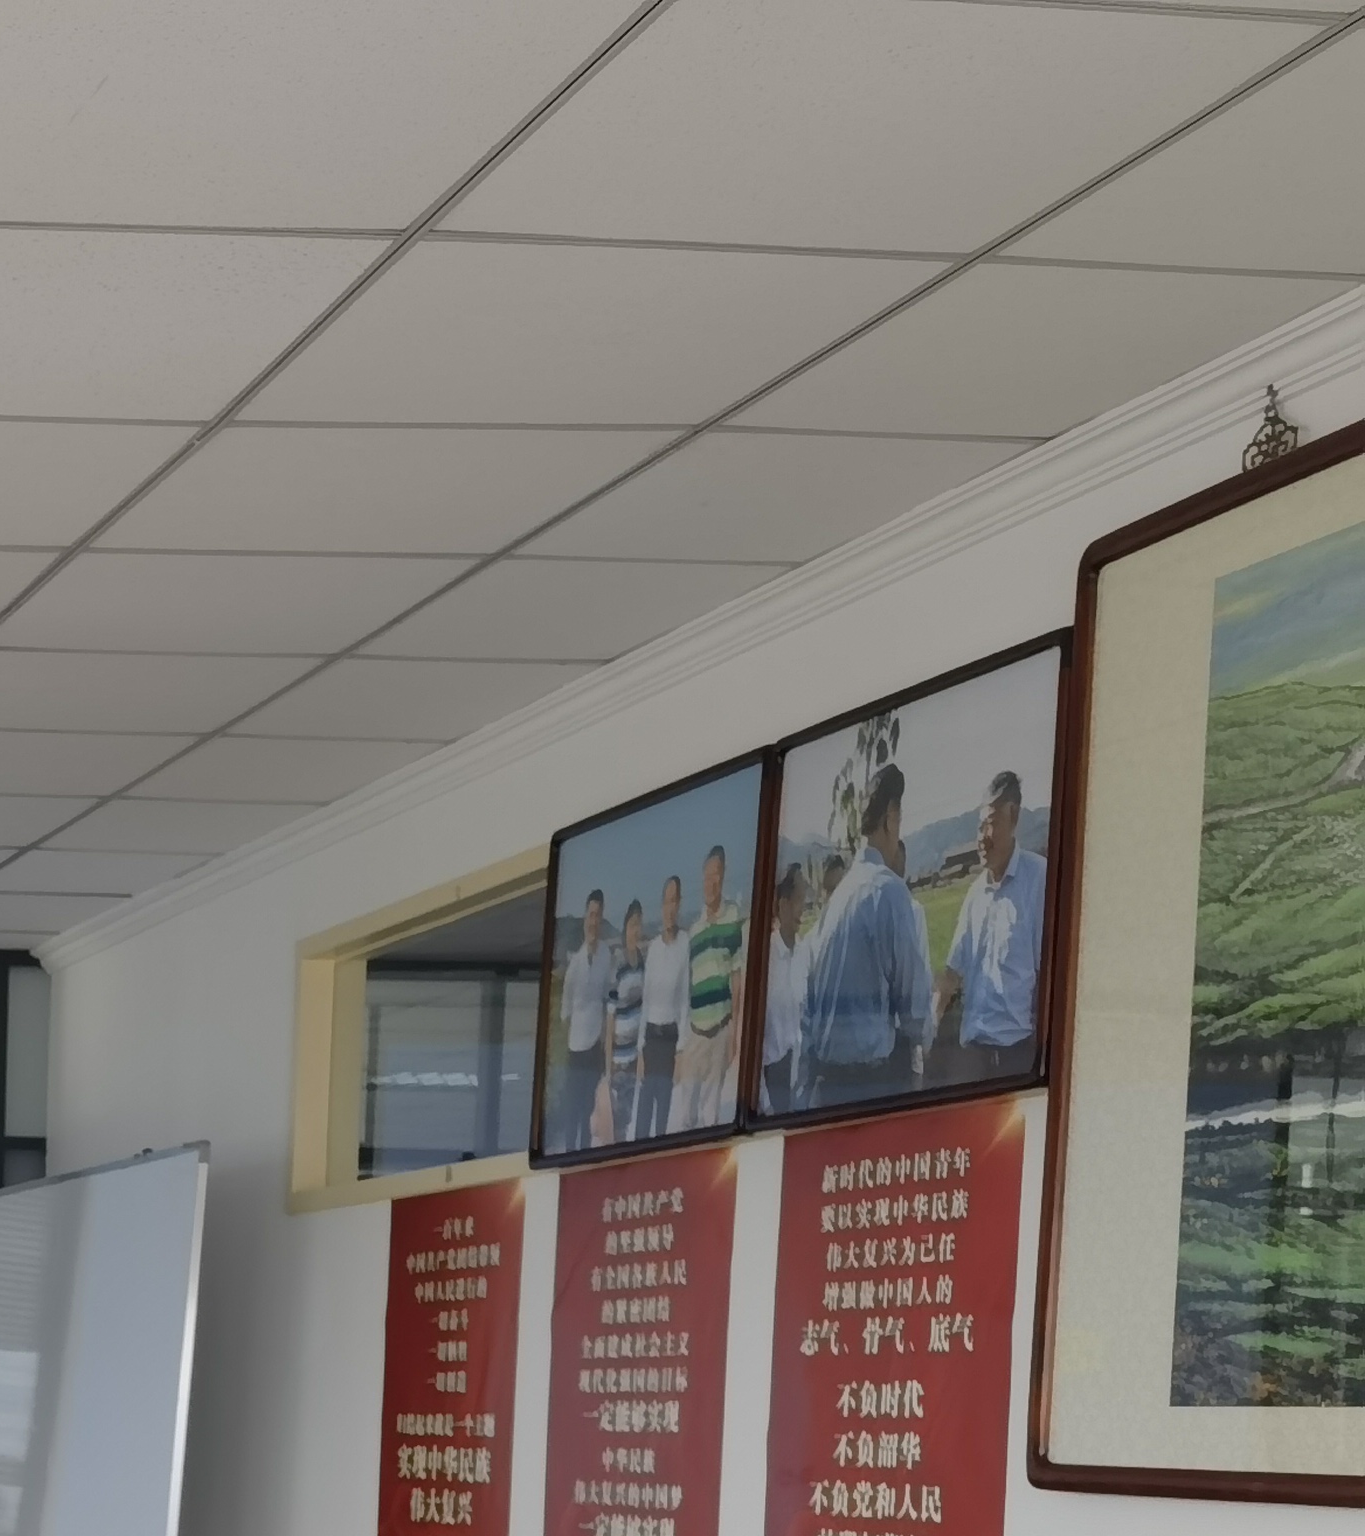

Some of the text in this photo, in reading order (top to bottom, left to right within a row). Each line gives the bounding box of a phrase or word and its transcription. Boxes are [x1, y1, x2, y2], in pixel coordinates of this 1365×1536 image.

[822, 1147, 971, 1193] 新时代的中国青年
[820, 1188, 969, 1233] 要以实现中华民族
[826, 1232, 956, 1272] 伟大复兴为己任
[822, 1274, 954, 1312] 增强做中国人的
[583, 1399, 679, 1433] 一定能够实现
[836, 1379, 925, 1418] 不负时代
[398, 1443, 491, 1483] 实现中华民族
[602, 1447, 655, 1474] 中华民族
[833, 1430, 922, 1470] 不负韶华
[410, 1487, 472, 1525] 伟大复兴
[574, 1479, 683, 1511] 伟大复兴的中国梦
[809, 1479, 942, 1524] 不负党和人民
